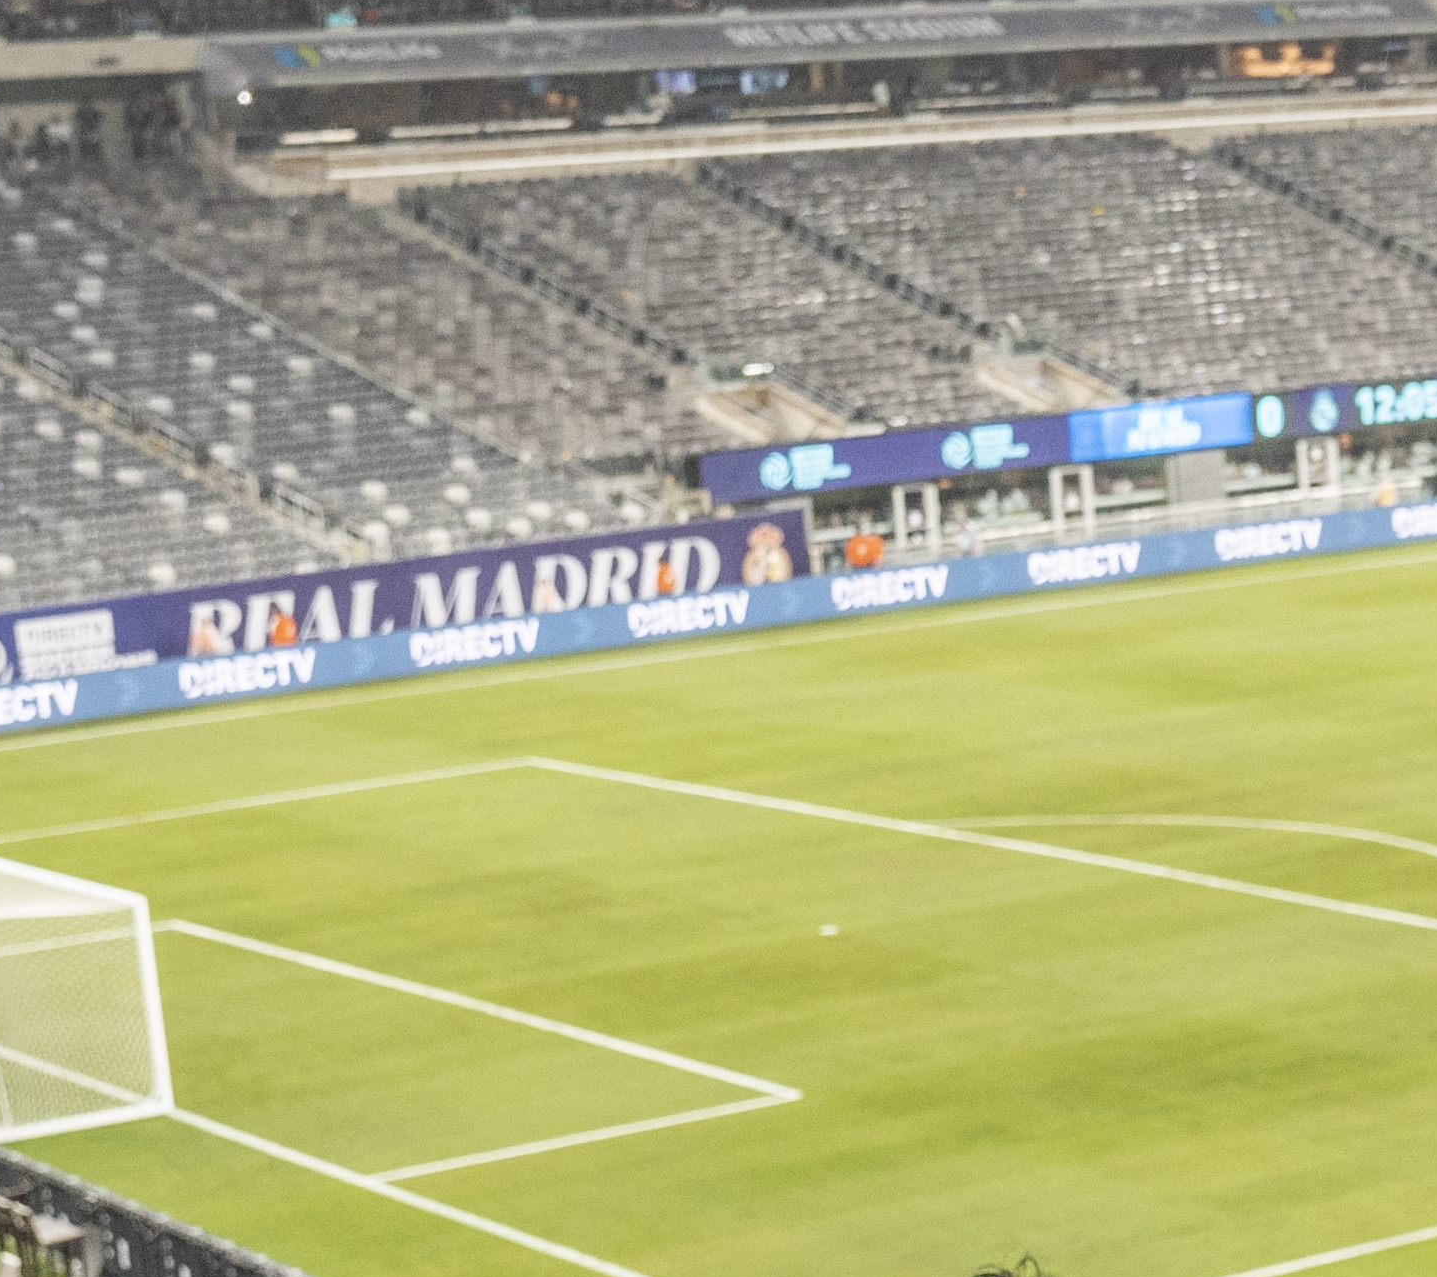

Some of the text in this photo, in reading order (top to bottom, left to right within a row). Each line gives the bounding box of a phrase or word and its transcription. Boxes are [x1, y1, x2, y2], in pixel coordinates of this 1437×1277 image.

[1255, 394, 1286, 437] 0
[1027, 541, 1141, 583] DIRECTV
[1214, 519, 1322, 561] DIRECTV
[189, 575, 395, 655] REAL
[411, 531, 722, 628] MADRID
[829, 561, 949, 613] DIRECTV
[627, 590, 750, 638] DIRECTV
[410, 619, 540, 668] DIRECTV
[178, 646, 316, 698] DIRECTV
